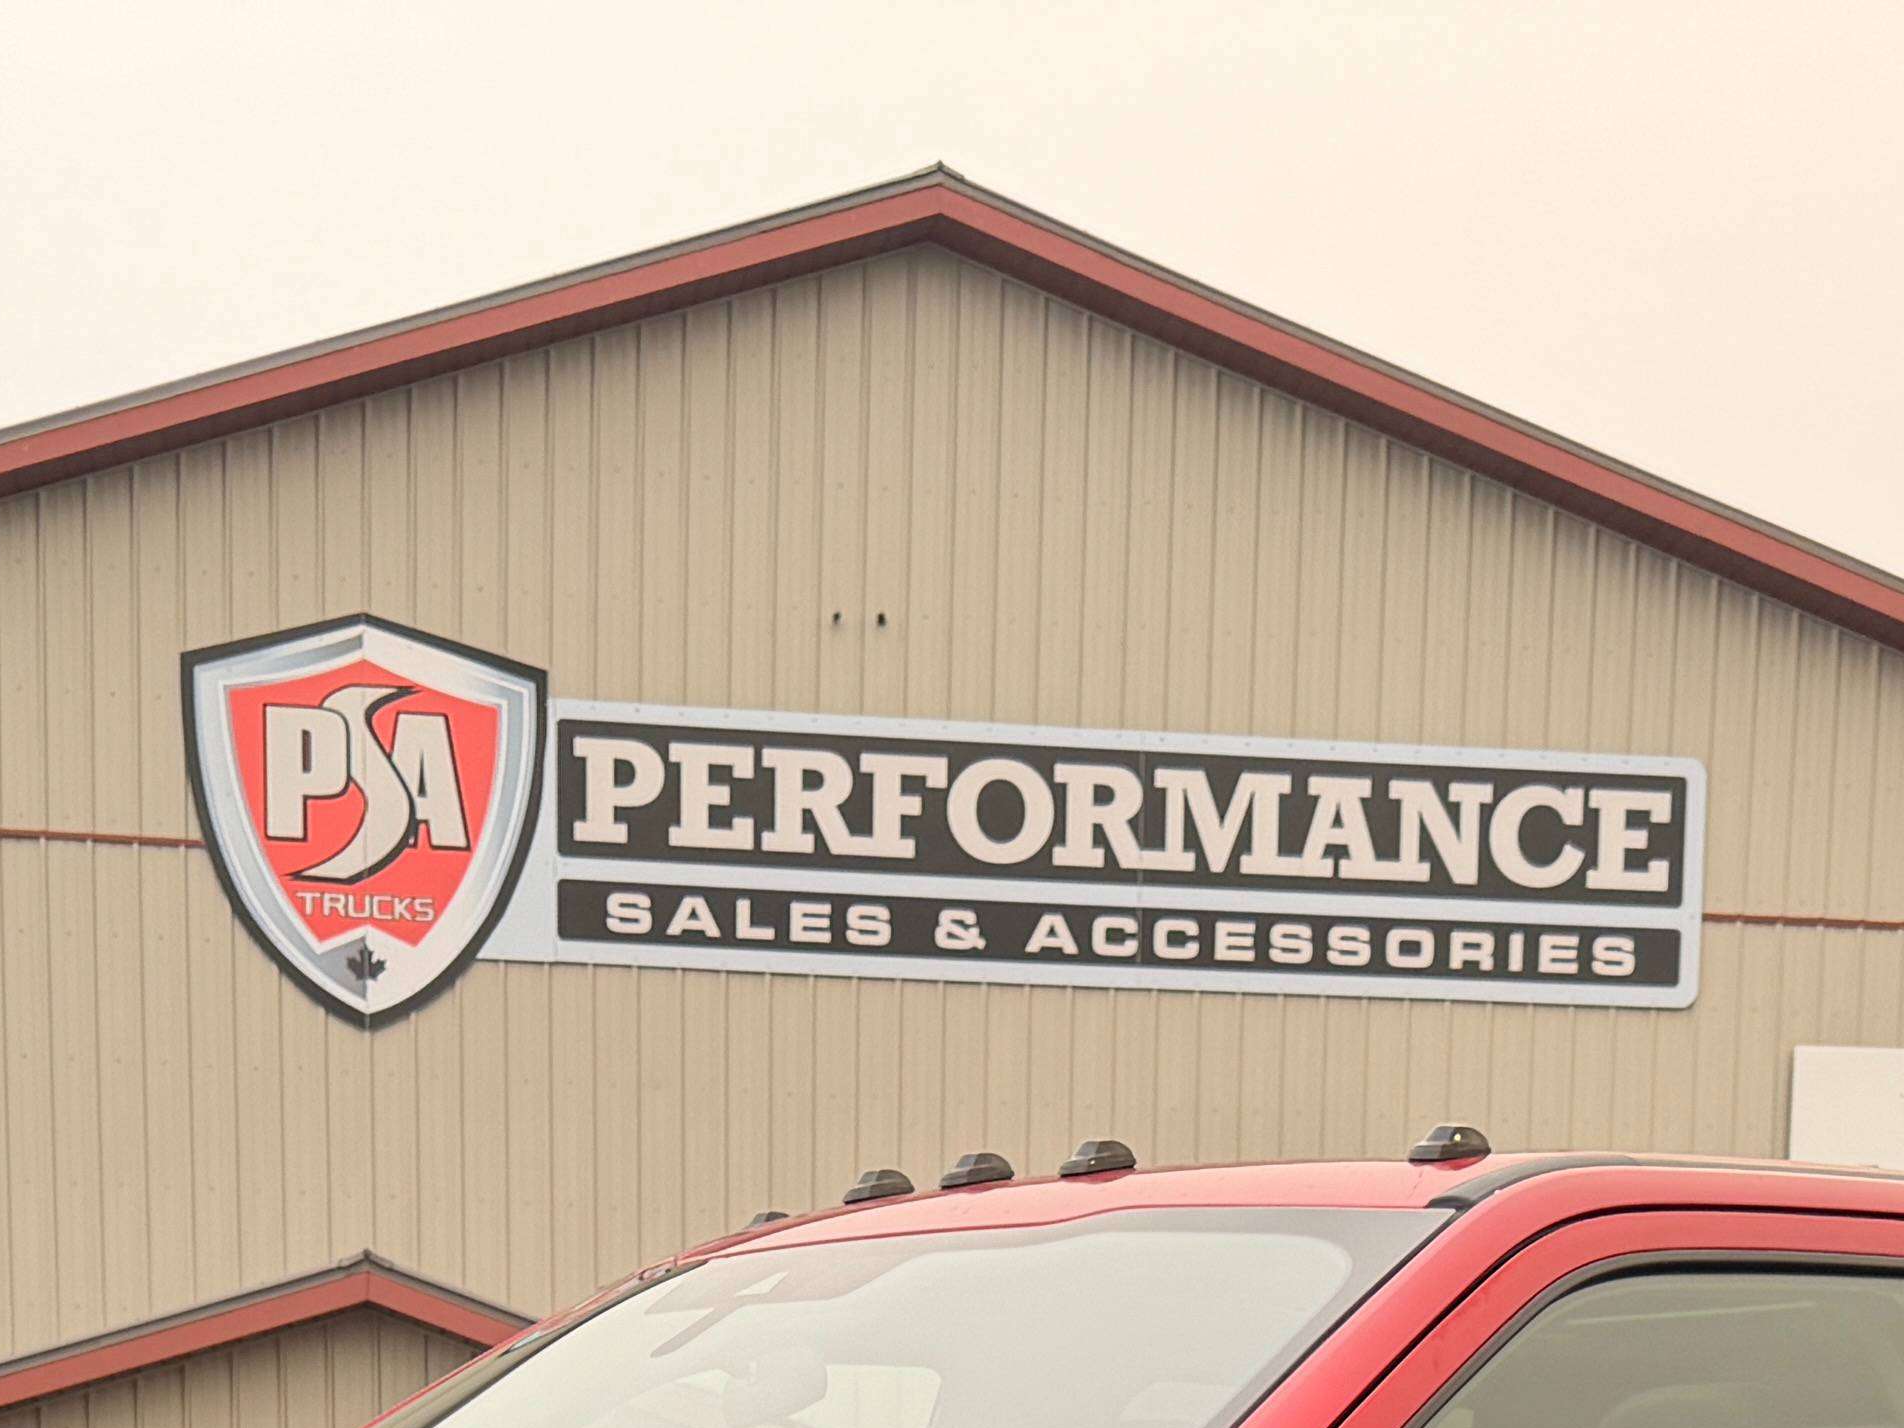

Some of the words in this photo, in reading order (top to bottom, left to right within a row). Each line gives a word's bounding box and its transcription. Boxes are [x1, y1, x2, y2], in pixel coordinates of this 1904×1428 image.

[263, 683, 472, 885] PSA
[572, 735, 1673, 892] PERFORMANCE
[297, 891, 436, 923] TRUCKS
[605, 892, 893, 946] SALES
[934, 909, 986, 951] &
[1025, 913, 1636, 977] ACCESSORIES
